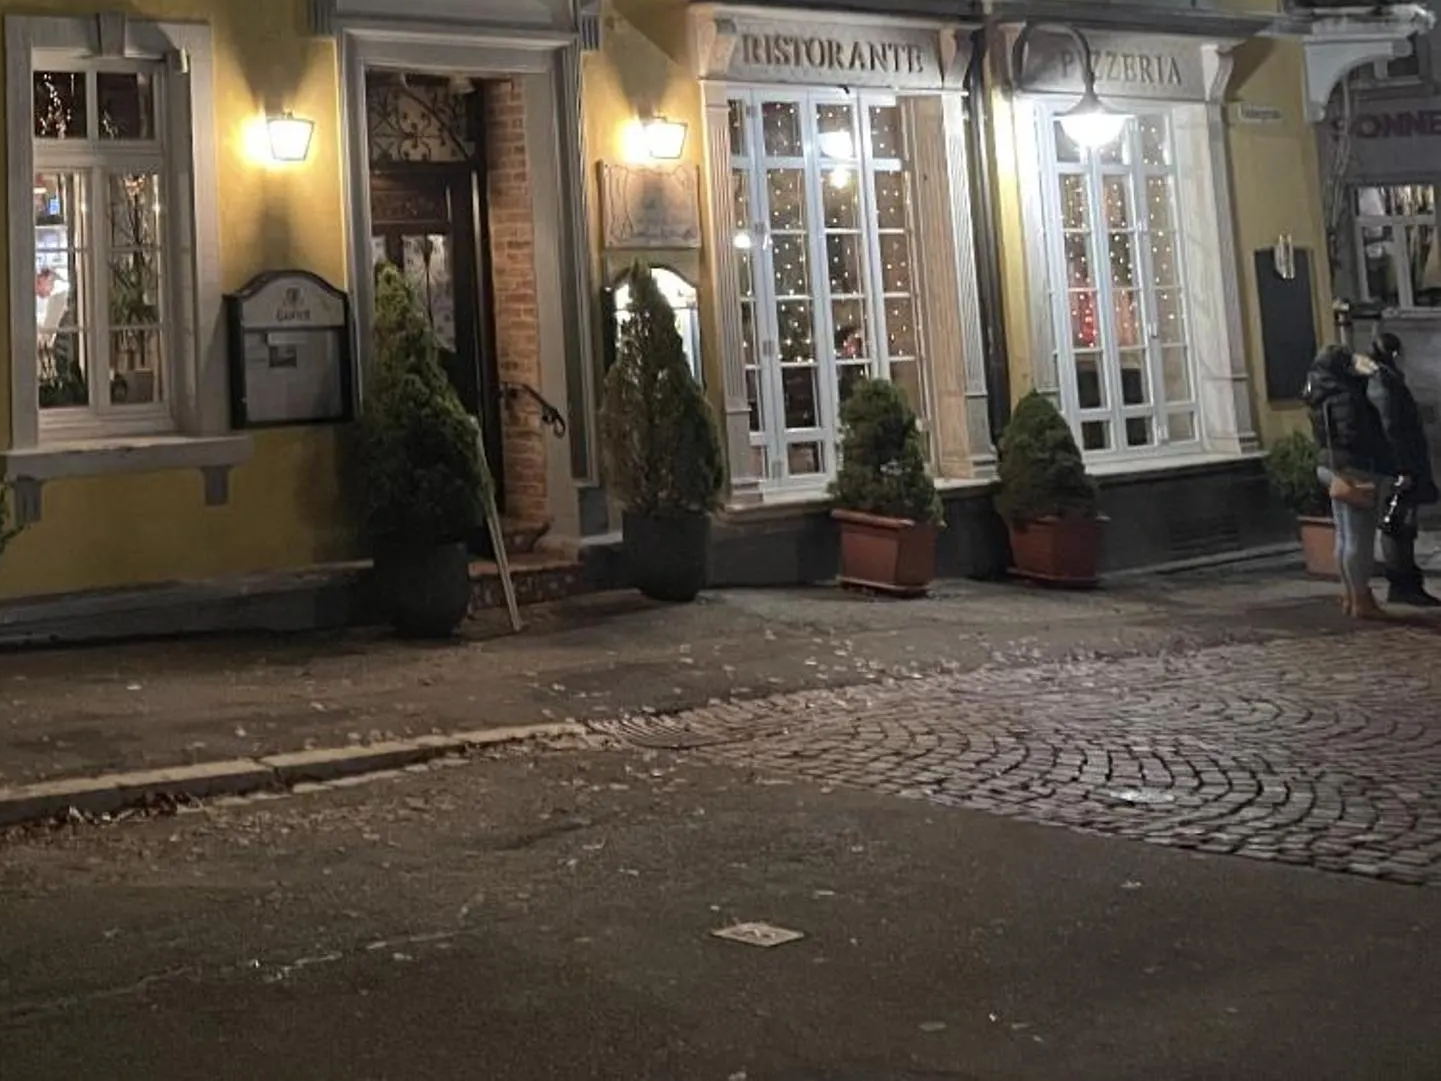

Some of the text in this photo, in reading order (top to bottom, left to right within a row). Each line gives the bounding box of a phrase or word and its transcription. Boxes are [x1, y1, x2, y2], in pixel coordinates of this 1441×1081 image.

[741, 34, 925, 73] RISTORANTE
[1061, 49, 1182, 86] PZZERIA
[1331, 109, 1441, 141] ONNE
